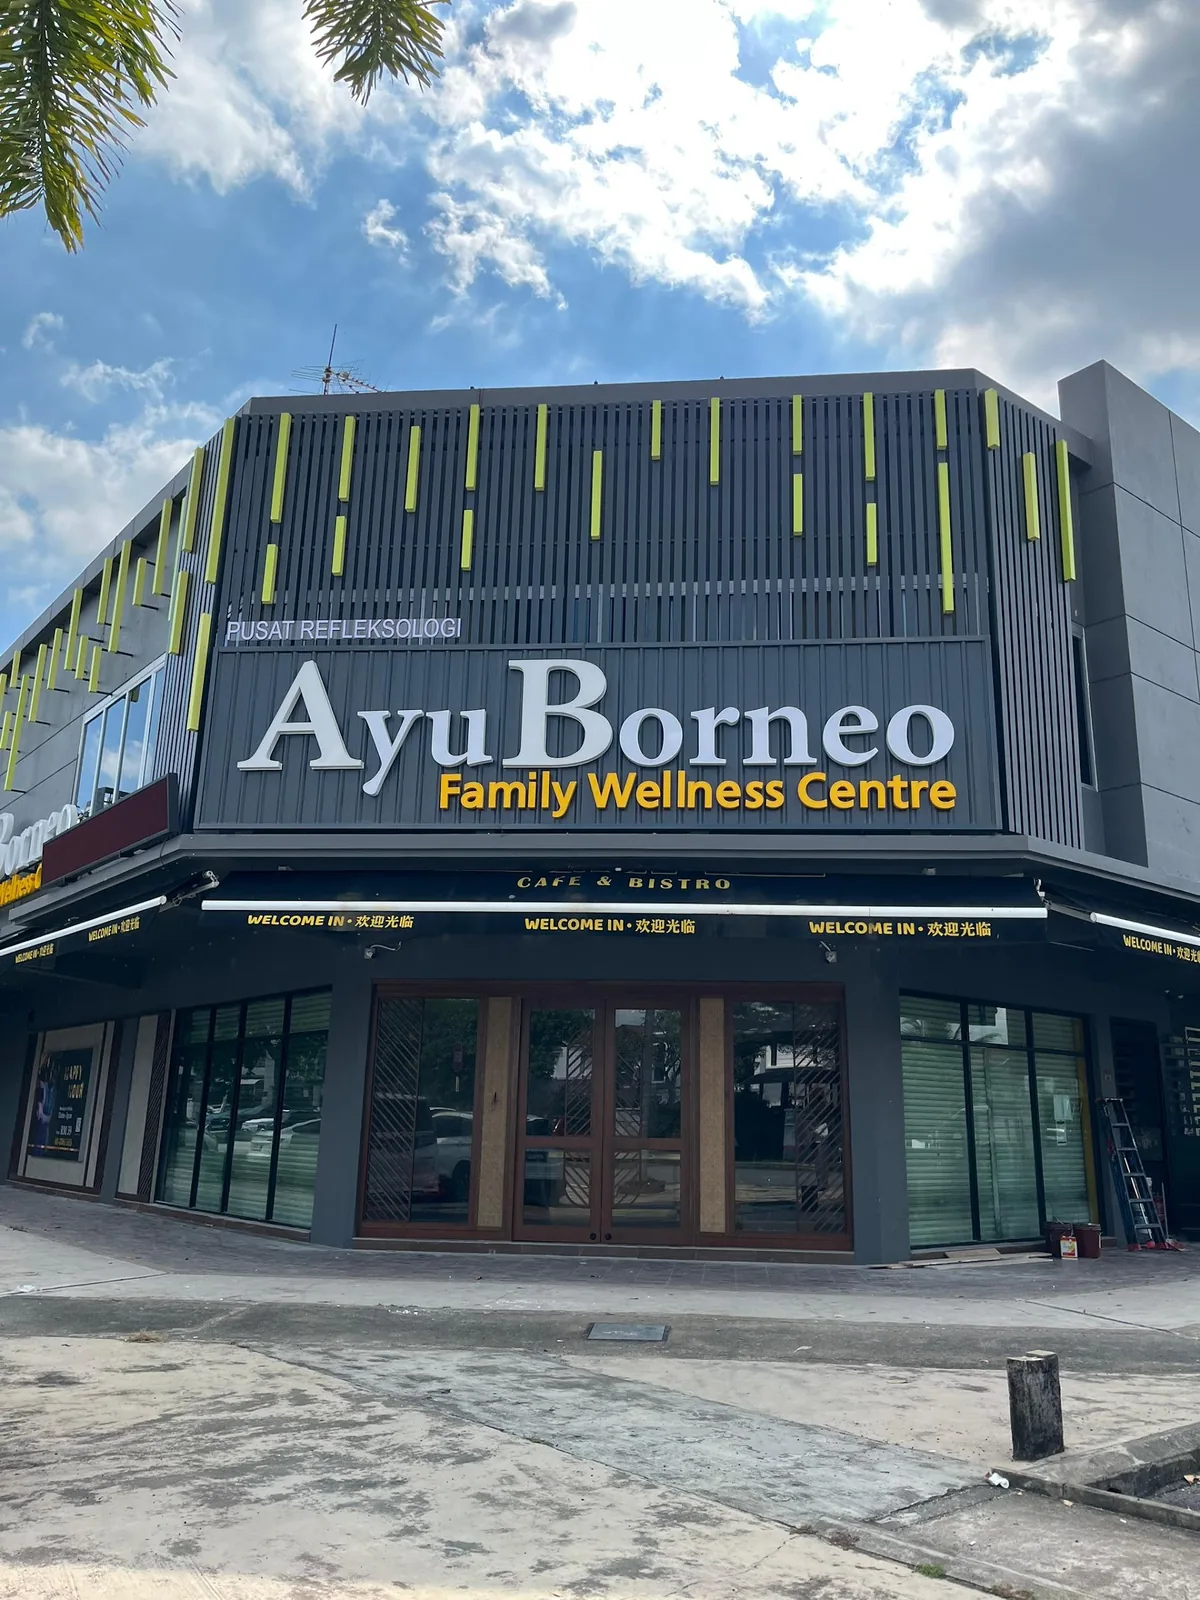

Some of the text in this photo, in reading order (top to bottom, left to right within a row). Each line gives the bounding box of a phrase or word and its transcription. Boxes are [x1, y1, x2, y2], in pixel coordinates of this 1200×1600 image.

[226, 618, 462, 641] PUSAT REFLEKSOLOGI
[438, 769, 957, 818] Family Wellness Centre
[516, 875, 731, 890] CAFE & BISTRO
[247, 914, 325, 927] WELCOME
[354, 914, 415, 929] 欢迎光临
[524, 917, 604, 931] WELCOME
[635, 918, 696, 935] 欢迎光临
[808, 921, 893, 935] WELCOME
[927, 921, 992, 937] 欢迎光临
[1122, 934, 1163, 954] WELCOME
